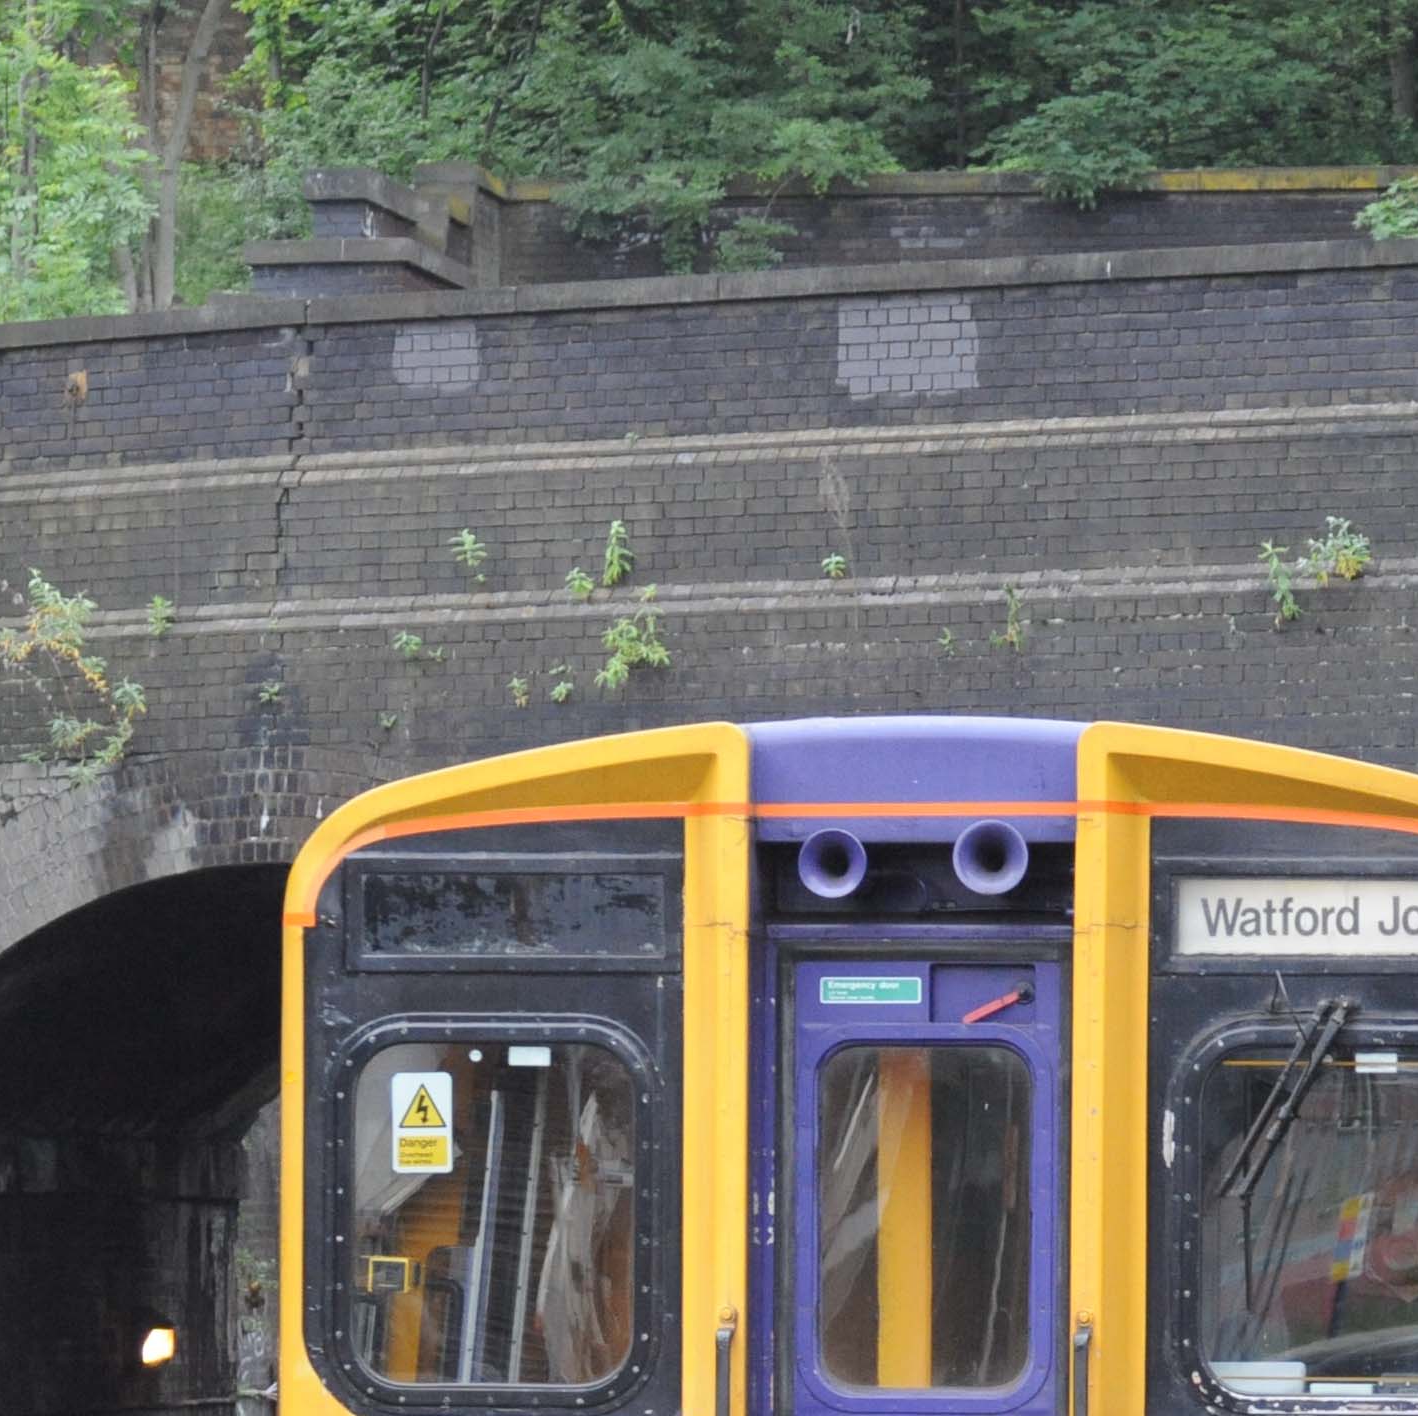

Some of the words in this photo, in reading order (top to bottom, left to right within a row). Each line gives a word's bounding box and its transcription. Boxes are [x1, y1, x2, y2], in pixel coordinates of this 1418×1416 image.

[1200, 895, 1360, 937] Watford
[828, 981, 876, 991] Emergency
[400, 1138, 437, 1149] Danger
